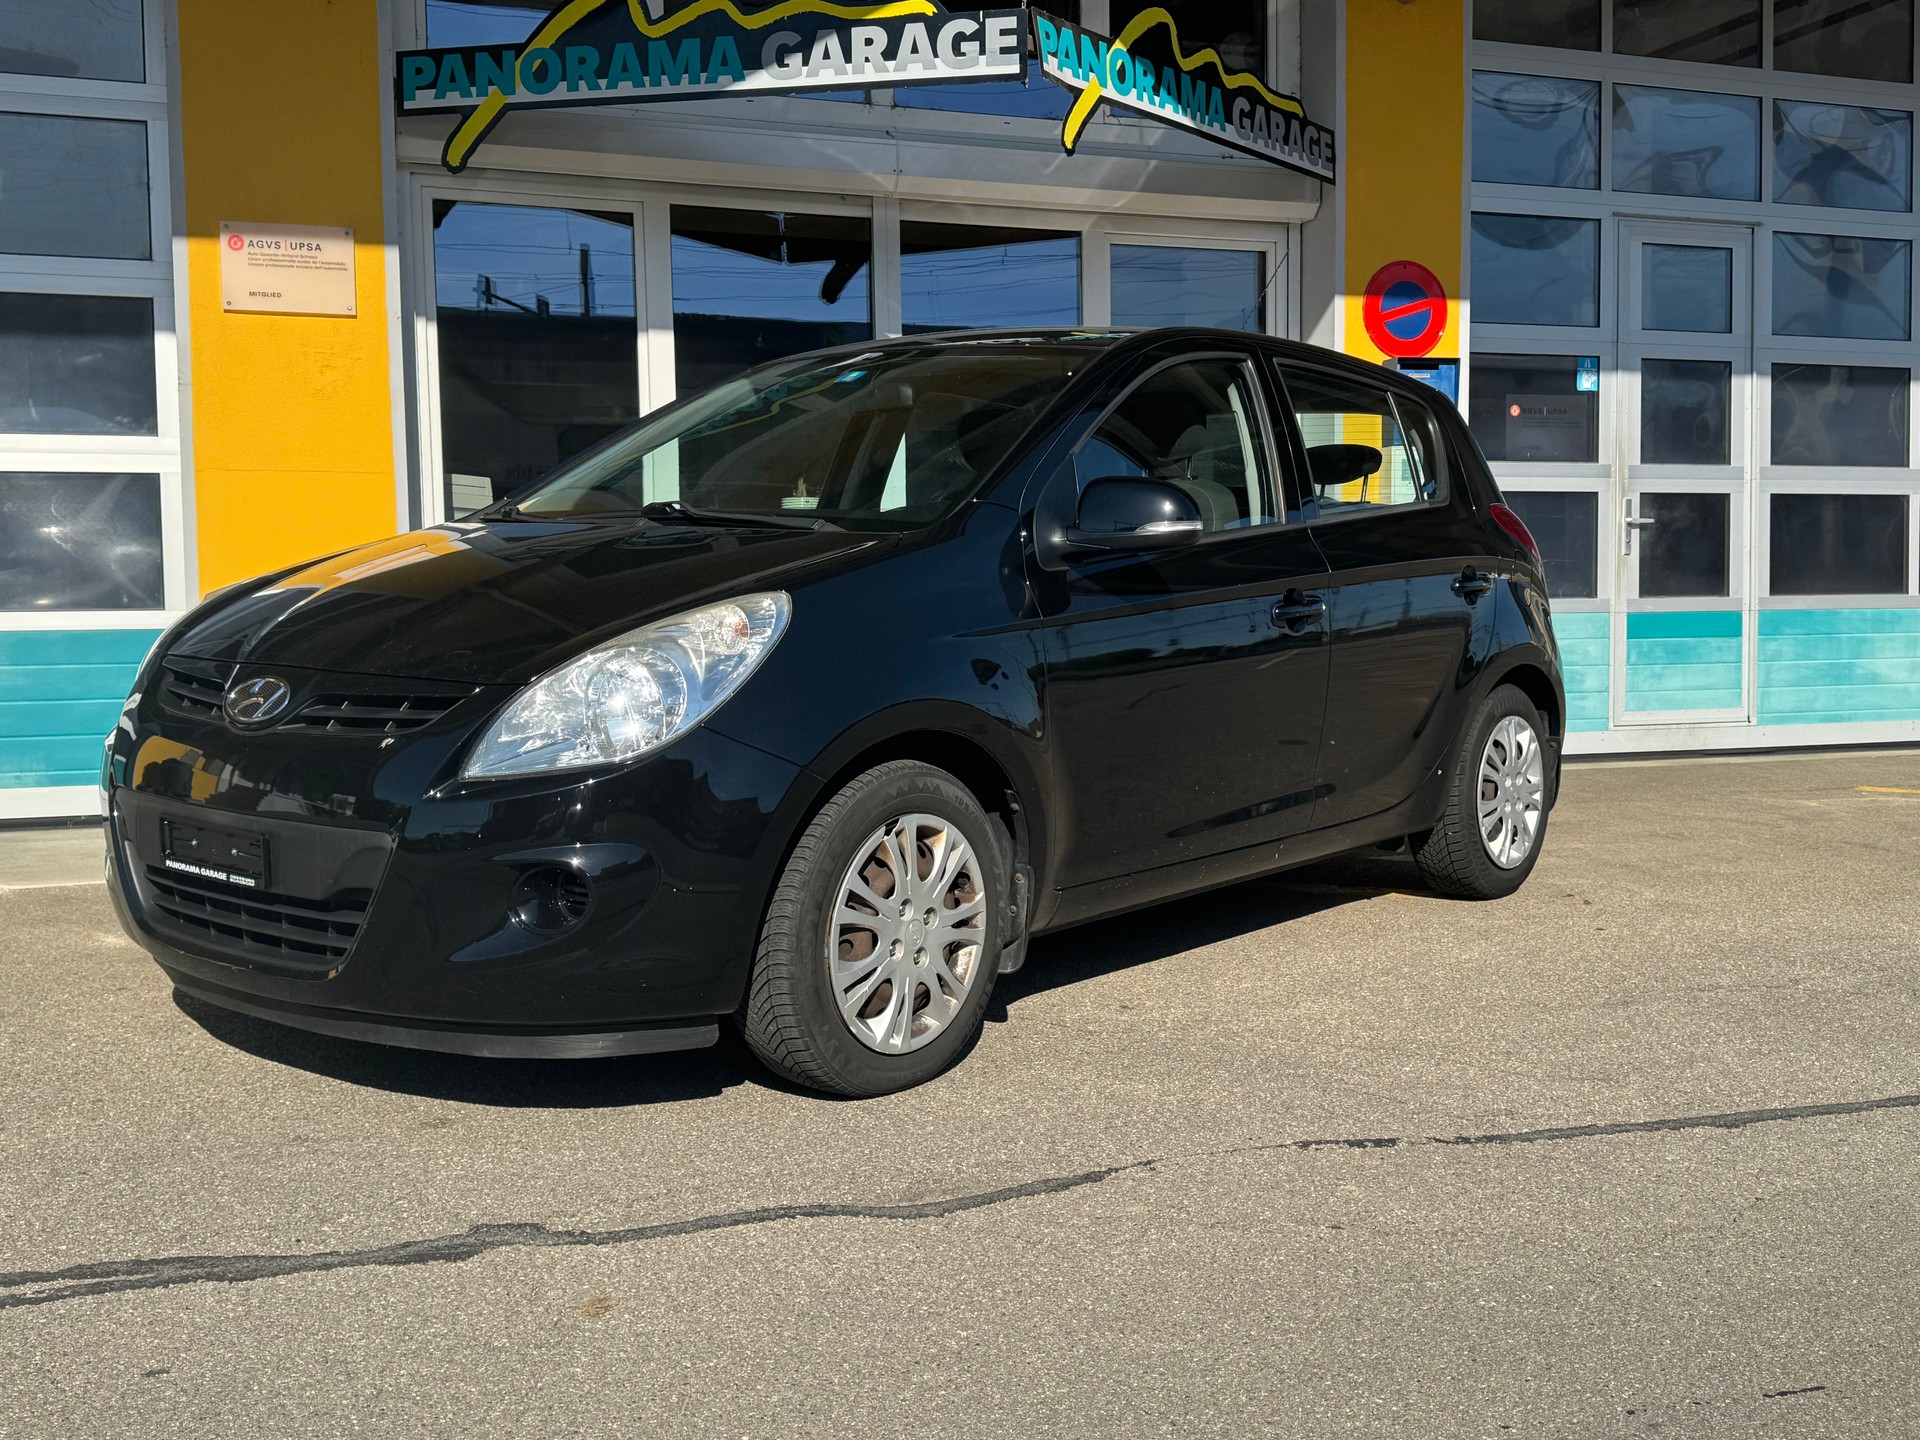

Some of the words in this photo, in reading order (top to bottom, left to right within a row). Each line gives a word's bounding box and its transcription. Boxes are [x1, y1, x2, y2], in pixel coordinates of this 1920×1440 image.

[403, 35, 748, 101] PANORAMA
[760, 15, 1020, 82] GARAGE
[1036, 15, 1227, 133] PANORAMA
[1232, 96, 1335, 172] GARAGE
[247, 239, 282, 250] AGVS
[289, 241, 322, 252] UPSA
[248, 290, 282, 298] MITGLIED
[165, 859, 201, 875] PANORAMA
[200, 867, 228, 881] GARAGE
